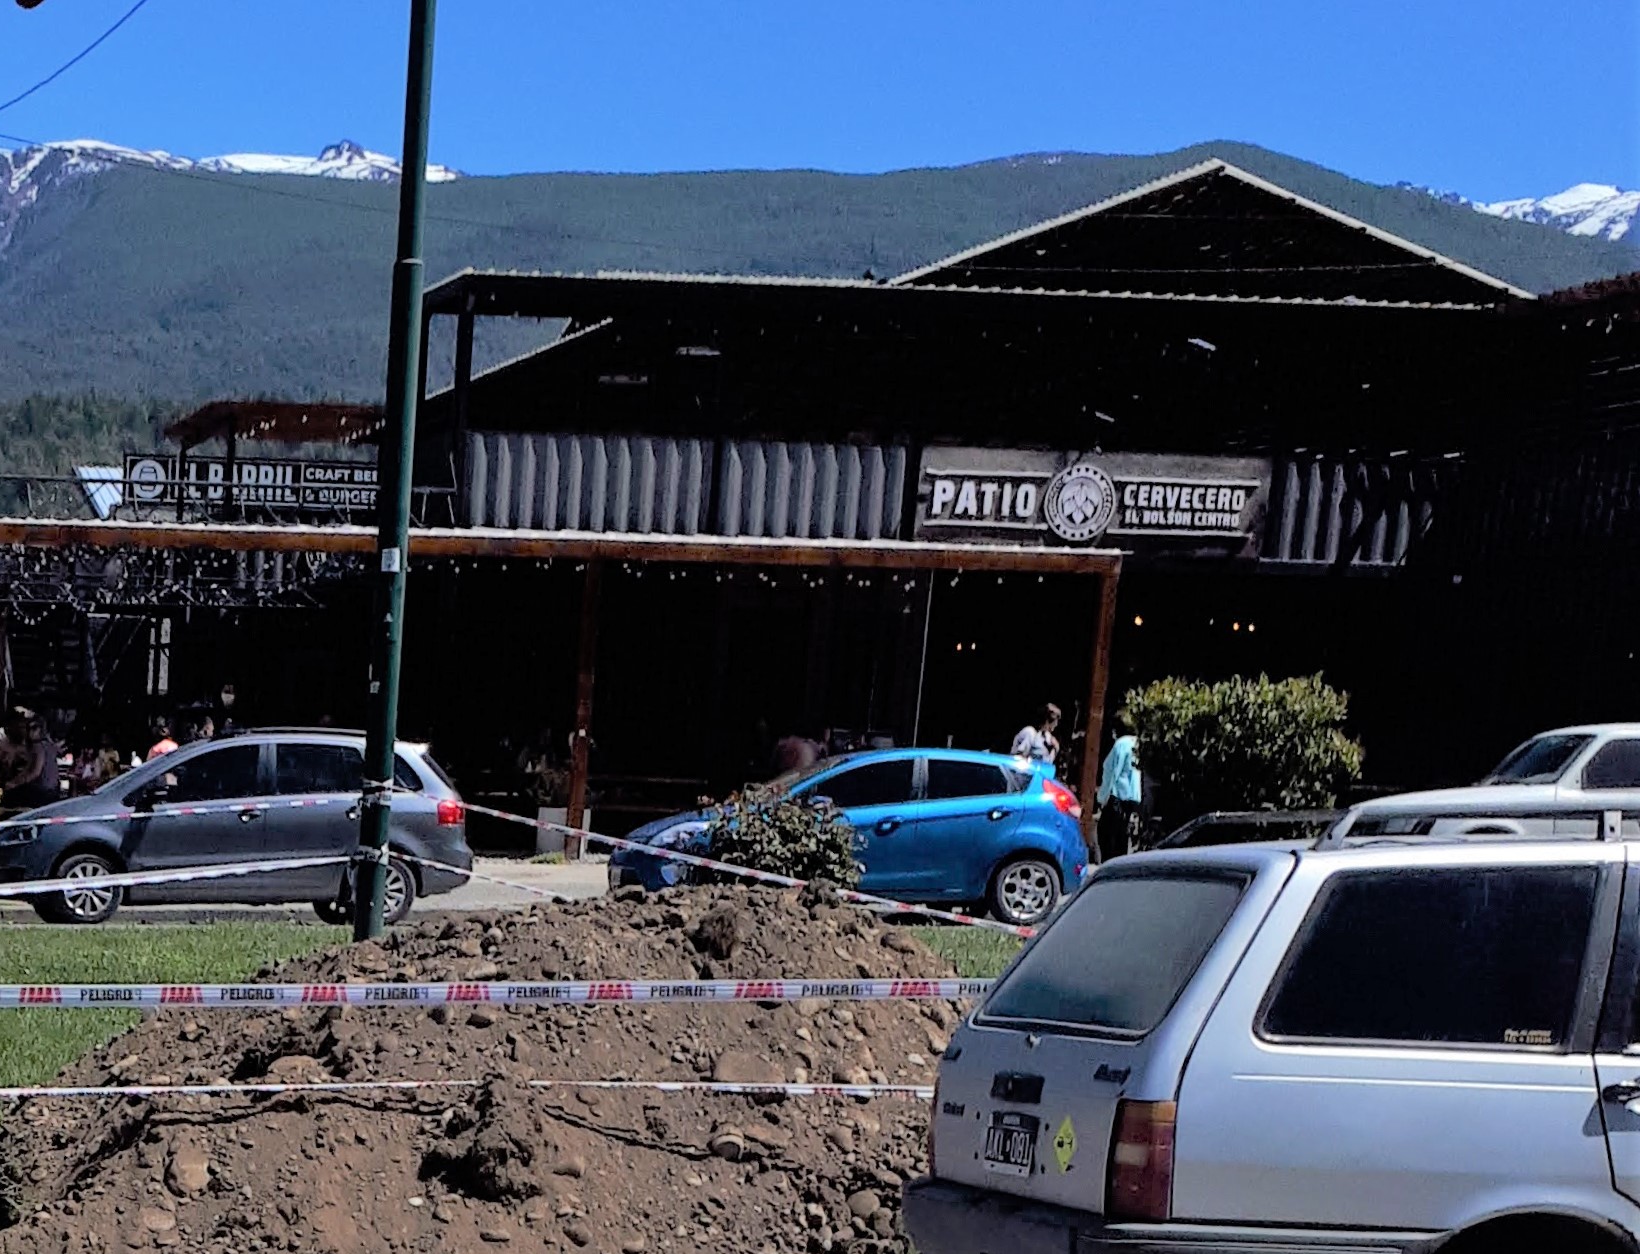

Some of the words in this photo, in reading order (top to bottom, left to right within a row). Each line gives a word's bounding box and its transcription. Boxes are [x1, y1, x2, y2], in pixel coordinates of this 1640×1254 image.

[305, 467, 351, 482] CRAFT
[931, 480, 1036, 518] PATIO
[1123, 484, 1246, 511] CERVECERO
[1193, 511, 1241, 528] CENTRO
[80, 988, 132, 1002] PELIGRO
[220, 988, 273, 1001] PELIGRO
[364, 986, 417, 1000] PELIGRO
